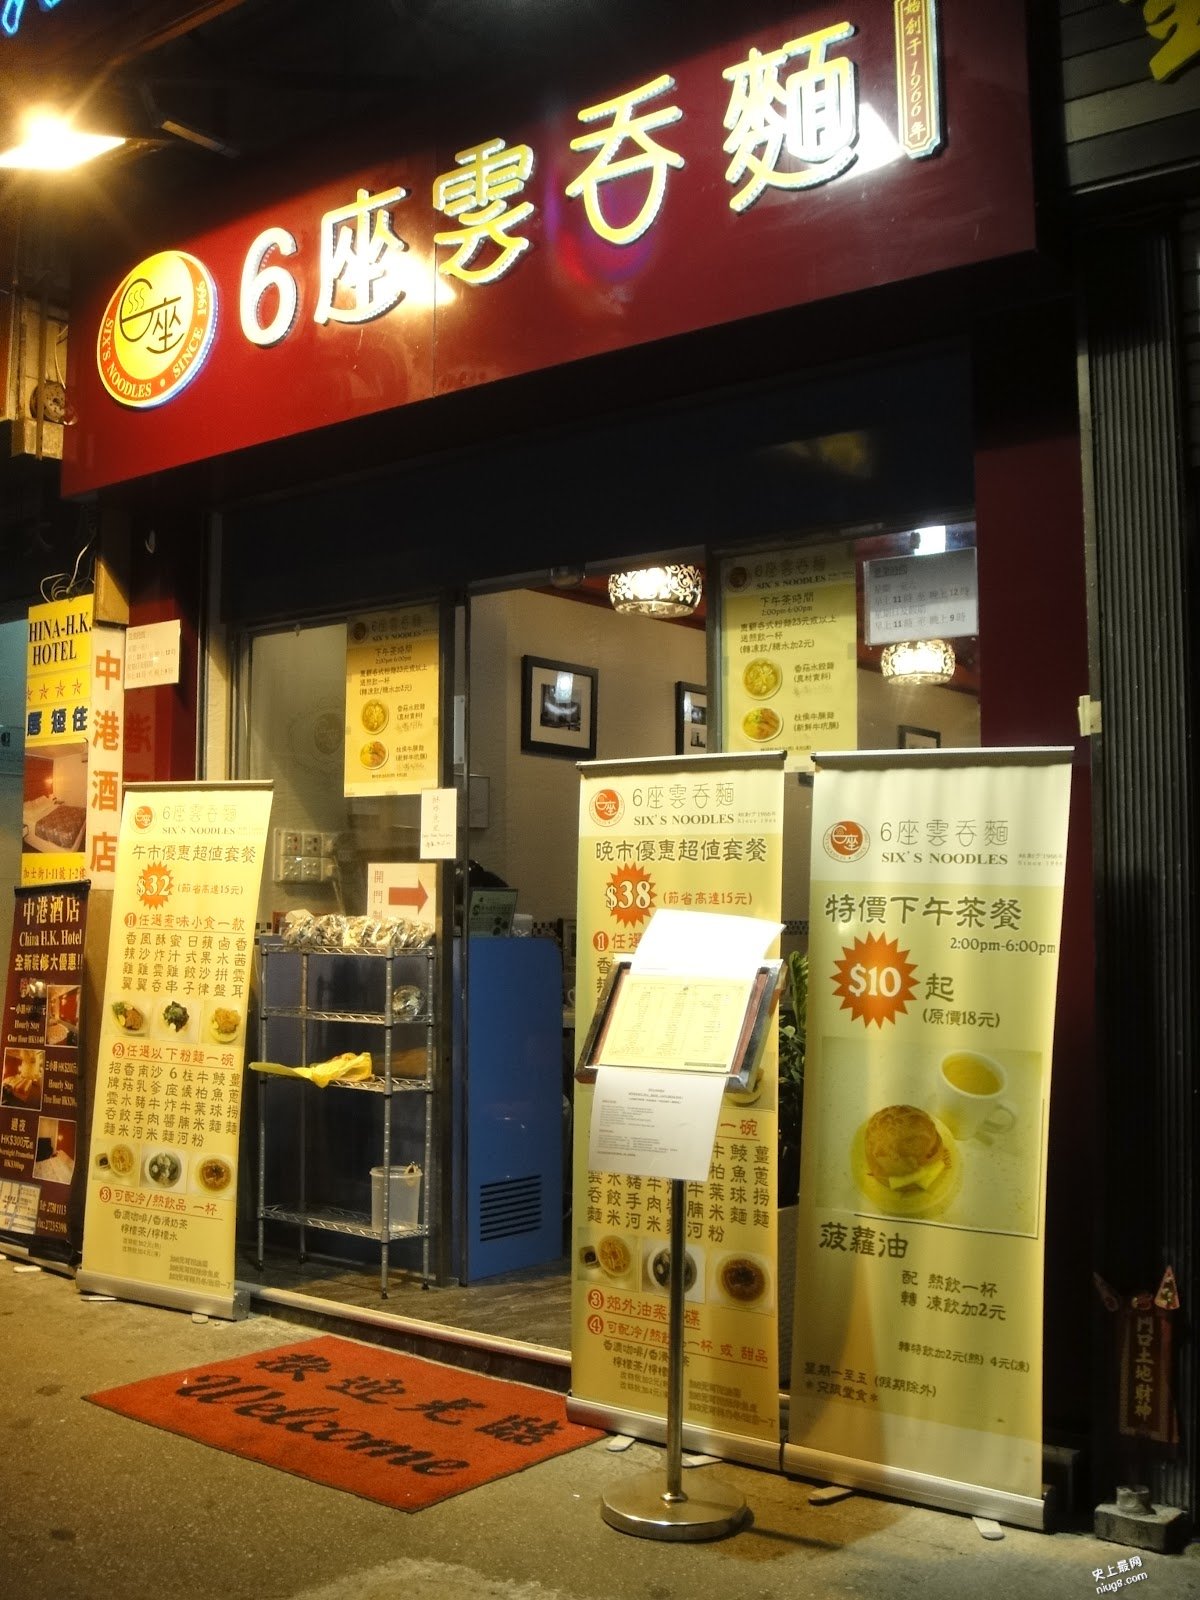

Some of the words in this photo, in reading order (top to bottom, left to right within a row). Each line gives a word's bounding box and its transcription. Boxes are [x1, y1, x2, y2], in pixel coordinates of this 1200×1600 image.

[101, 317, 115, 362] SIX'S
[172, 327, 204, 378] SINCE
[107, 361, 152, 398] NOODLES
[33, 640, 77, 667] HOTEL
[90, 650, 121, 873] 中港酒店
[189, 826, 235, 836] NOODLES
[672, 814, 734, 825] NOODLES
[132, 844, 256, 864] 午市優惠超值套餐
[595, 837, 767, 863] 晚市優惠超值套餐
[929, 852, 1008, 865] NOODLES
[137, 874, 171, 897] $32
[177, 883, 244, 896] (節省高達15元)
[606, 880, 651, 911] $38
[23, 895, 80, 925] 中港酒店
[663, 892, 753, 906] (節省高達15元)
[825, 894, 1022, 931] 特價下午茶餐
[19, 931, 39, 947] China
[41, 930, 59, 946] H.K.
[61, 929, 82, 945] Hotel
[950, 937, 1056, 956] 2:00pm-6:00pm
[183, 935, 199, 996] 日式餃子
[848, 963, 902, 997] $10
[925, 973, 955, 1002] 起
[922, 1008, 1000, 1029] (原價18元)
[126, 1044, 235, 1067] 任選以下粉麵一碗
[114, 1189, 187, 1212] 可配冷/熱飲品
[121, 1224, 178, 1241] 檸檬茶/檸檬水
[819, 1221, 908, 1259] 菠蘿油
[902, 1270, 919, 1286] 配
[928, 1273, 998, 1299] 熱飲一杯
[607, 1295, 701, 1327] 郊外油菜碟
[901, 1291, 918, 1308] 轉
[926, 1296, 1007, 1321] 凍飲加2元
[613, 1356, 669, 1376] 檸檬茶/檸檬
[255, 1352, 563, 1447] 歡迎光臨
[874, 1375, 937, 1398] (假期除外)
[175, 1373, 471, 1476] Welcome
